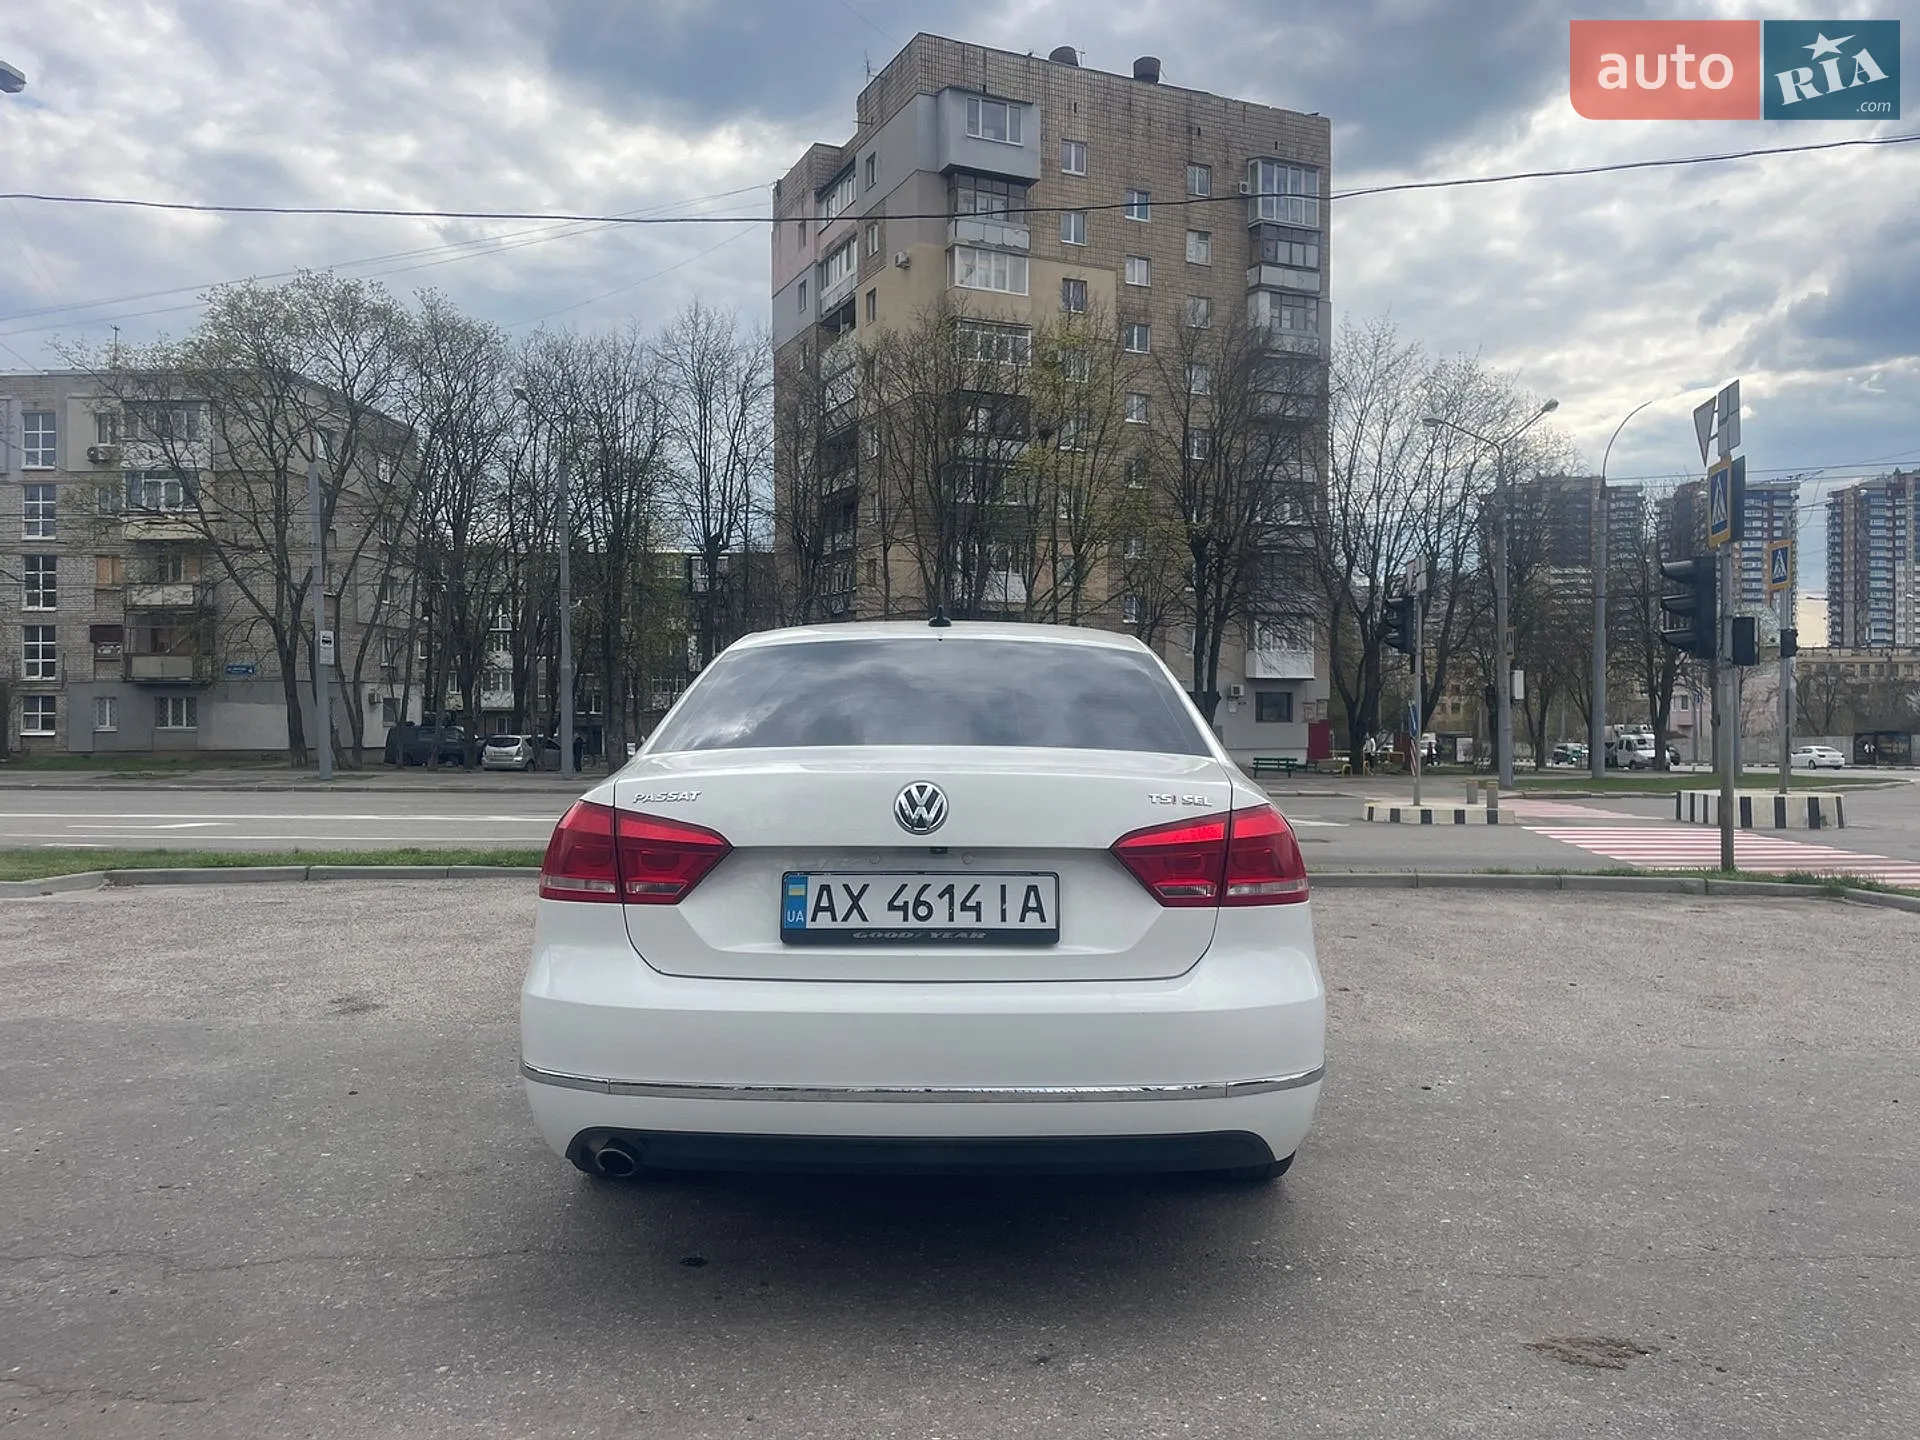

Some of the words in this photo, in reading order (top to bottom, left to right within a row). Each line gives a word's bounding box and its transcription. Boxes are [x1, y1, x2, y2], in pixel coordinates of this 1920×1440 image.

[632, 790, 703, 803] PASSAT
[1148, 793, 1176, 805] TSI
[1181, 794, 1213, 807] SEL
[810, 883, 870, 922] AX
[887, 883, 982, 922] 4614
[1000, 884, 1046, 923] IA
[786, 910, 804, 923] UA
